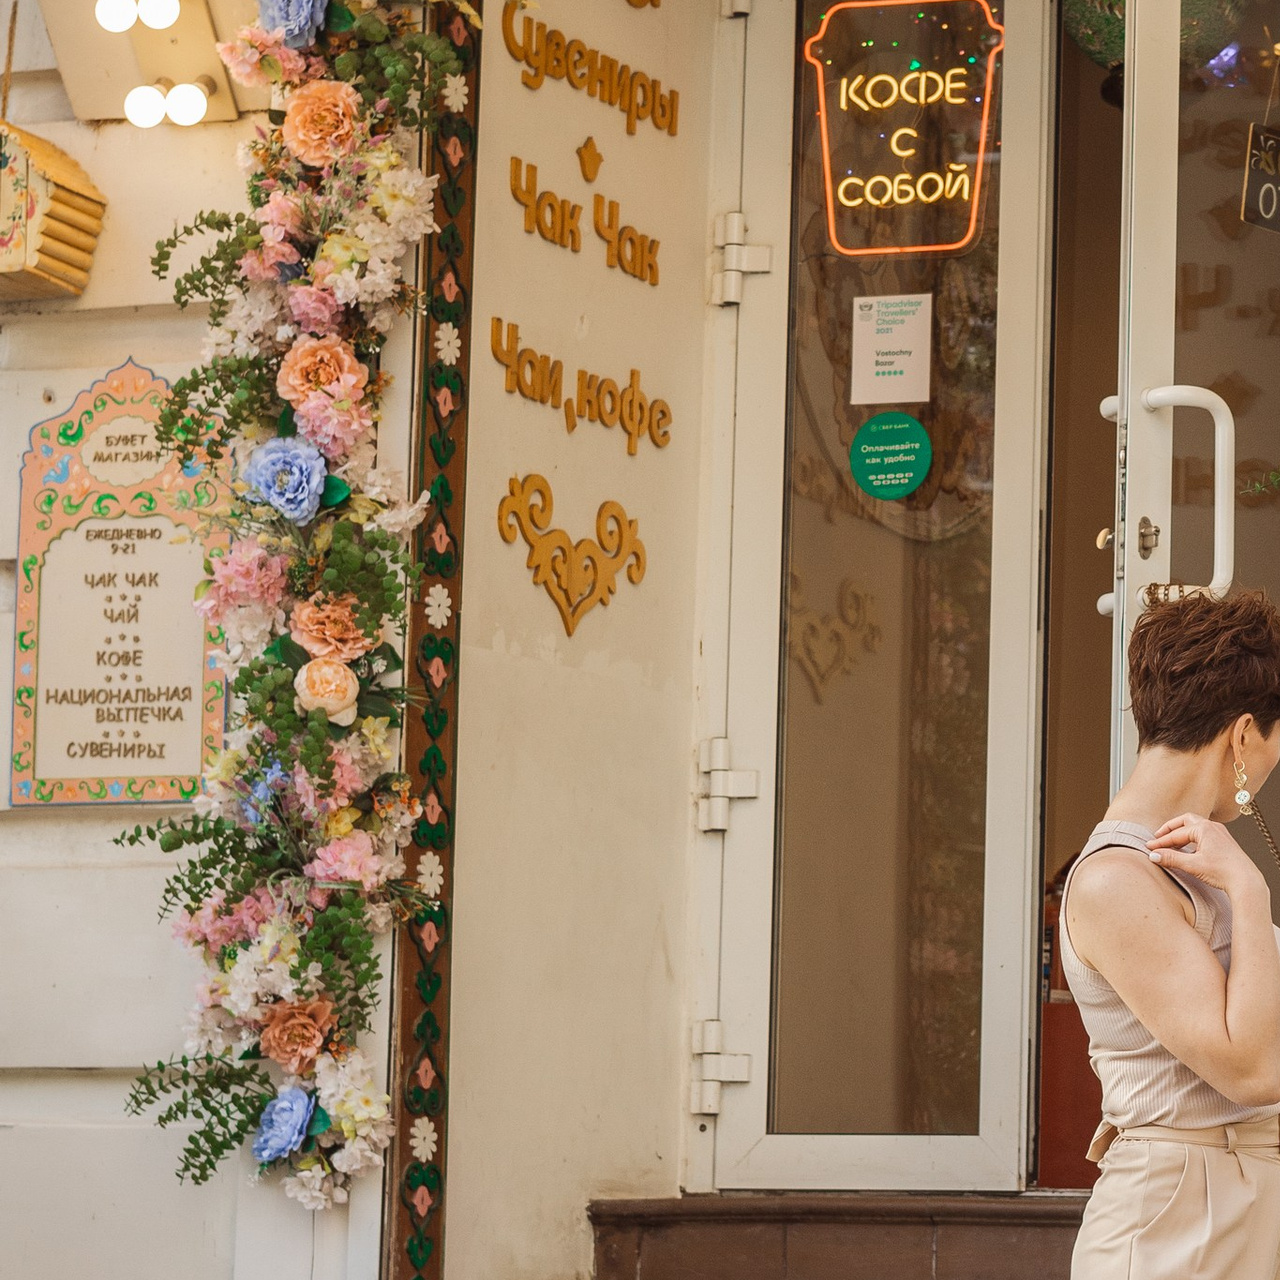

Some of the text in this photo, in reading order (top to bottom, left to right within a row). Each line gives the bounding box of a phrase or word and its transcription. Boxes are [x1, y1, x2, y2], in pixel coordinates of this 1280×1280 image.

[839, 67, 969, 112] КОФЕ
[890, 127, 918, 157] С
[837, 163, 970, 208] СОБОЙ
[510, 155, 661, 287] Чак Чак
[875, 300, 923, 310] Tripadvisor
[875, 318, 906, 326] Choice
[875, 327, 893, 335] 2021
[875, 349, 913, 357] Vostochny
[874, 359, 895, 367] Bazar
[577, 369, 673, 456] кофе
[105, 434, 148, 447] БУФЕТ
[861, 441, 921, 453] Оплачивайте
[883, 453, 916, 466] удобно
[85, 528, 163, 541] ЕЖЕДНЕВНО
[110, 543, 137, 555] 9-21
[84, 572, 159, 589] ЧАК ЧАК
[103, 603, 139, 623] ЧАЙ
[96, 650, 144, 667] КОФЕ
[45, 686, 192, 706] НАЦИОНАЛЬНАЯ
[95, 706, 184, 724] ВЫПЕЧКА
[66, 741, 166, 759] СУВЕНИРЫ
